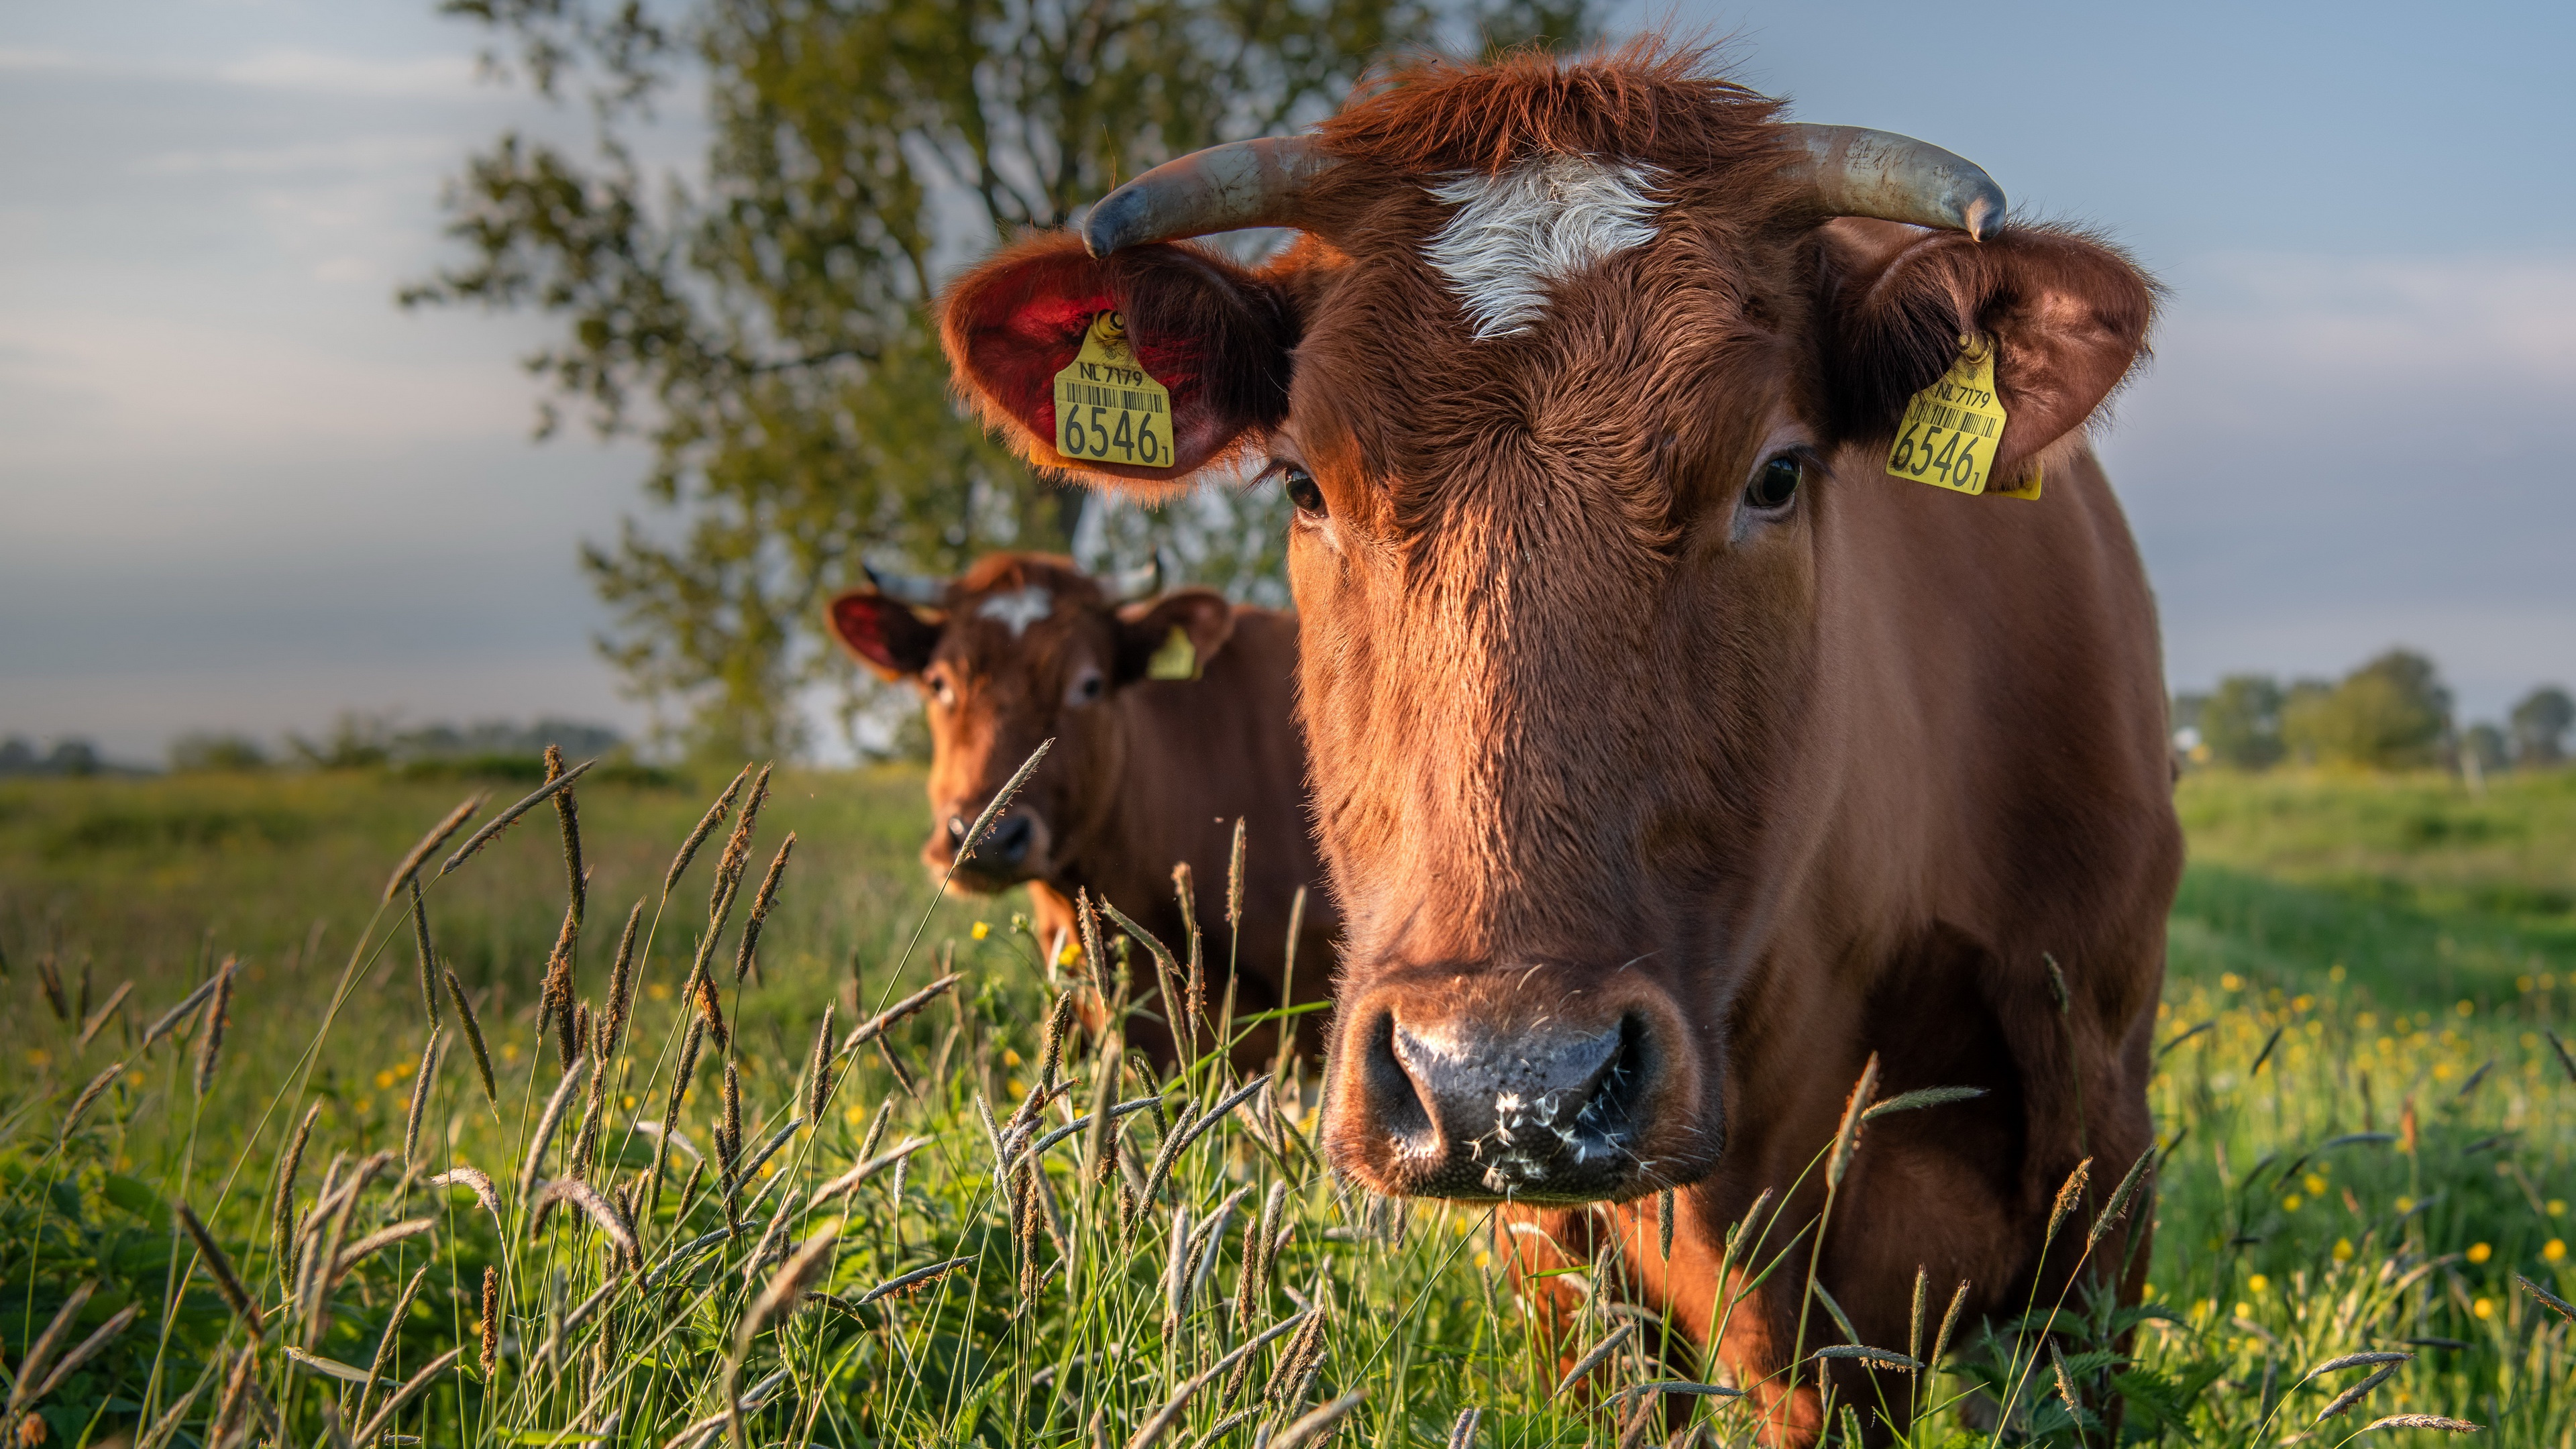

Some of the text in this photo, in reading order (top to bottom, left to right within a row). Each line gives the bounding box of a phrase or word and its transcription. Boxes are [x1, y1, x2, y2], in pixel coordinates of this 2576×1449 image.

[1079, 362, 1143, 387] NL 7179
[1935, 382, 1990, 409] NL 7179
[1065, 404, 1158, 463] 6546
[1894, 422, 1978, 487] 6546
